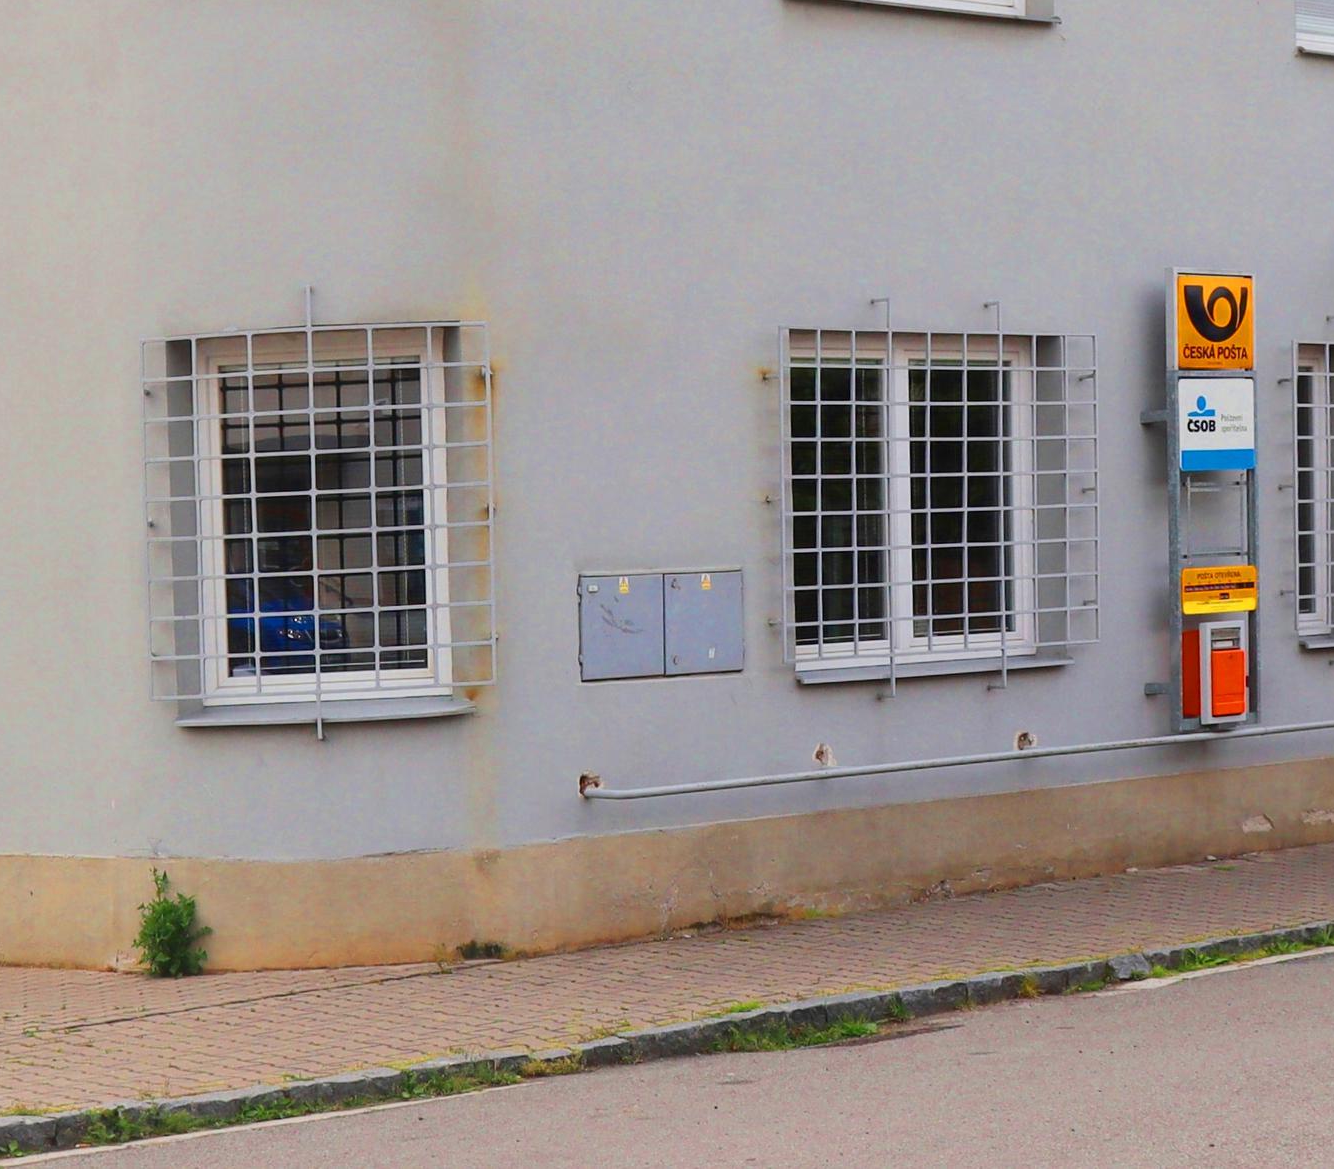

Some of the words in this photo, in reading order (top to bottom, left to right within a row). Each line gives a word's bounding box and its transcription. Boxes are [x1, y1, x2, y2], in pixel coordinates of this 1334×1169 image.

[1183, 343, 1215, 359] ČESKÁ
[1217, 343, 1248, 359] POŠTA
[1187, 418, 1216, 432] ČSOB
